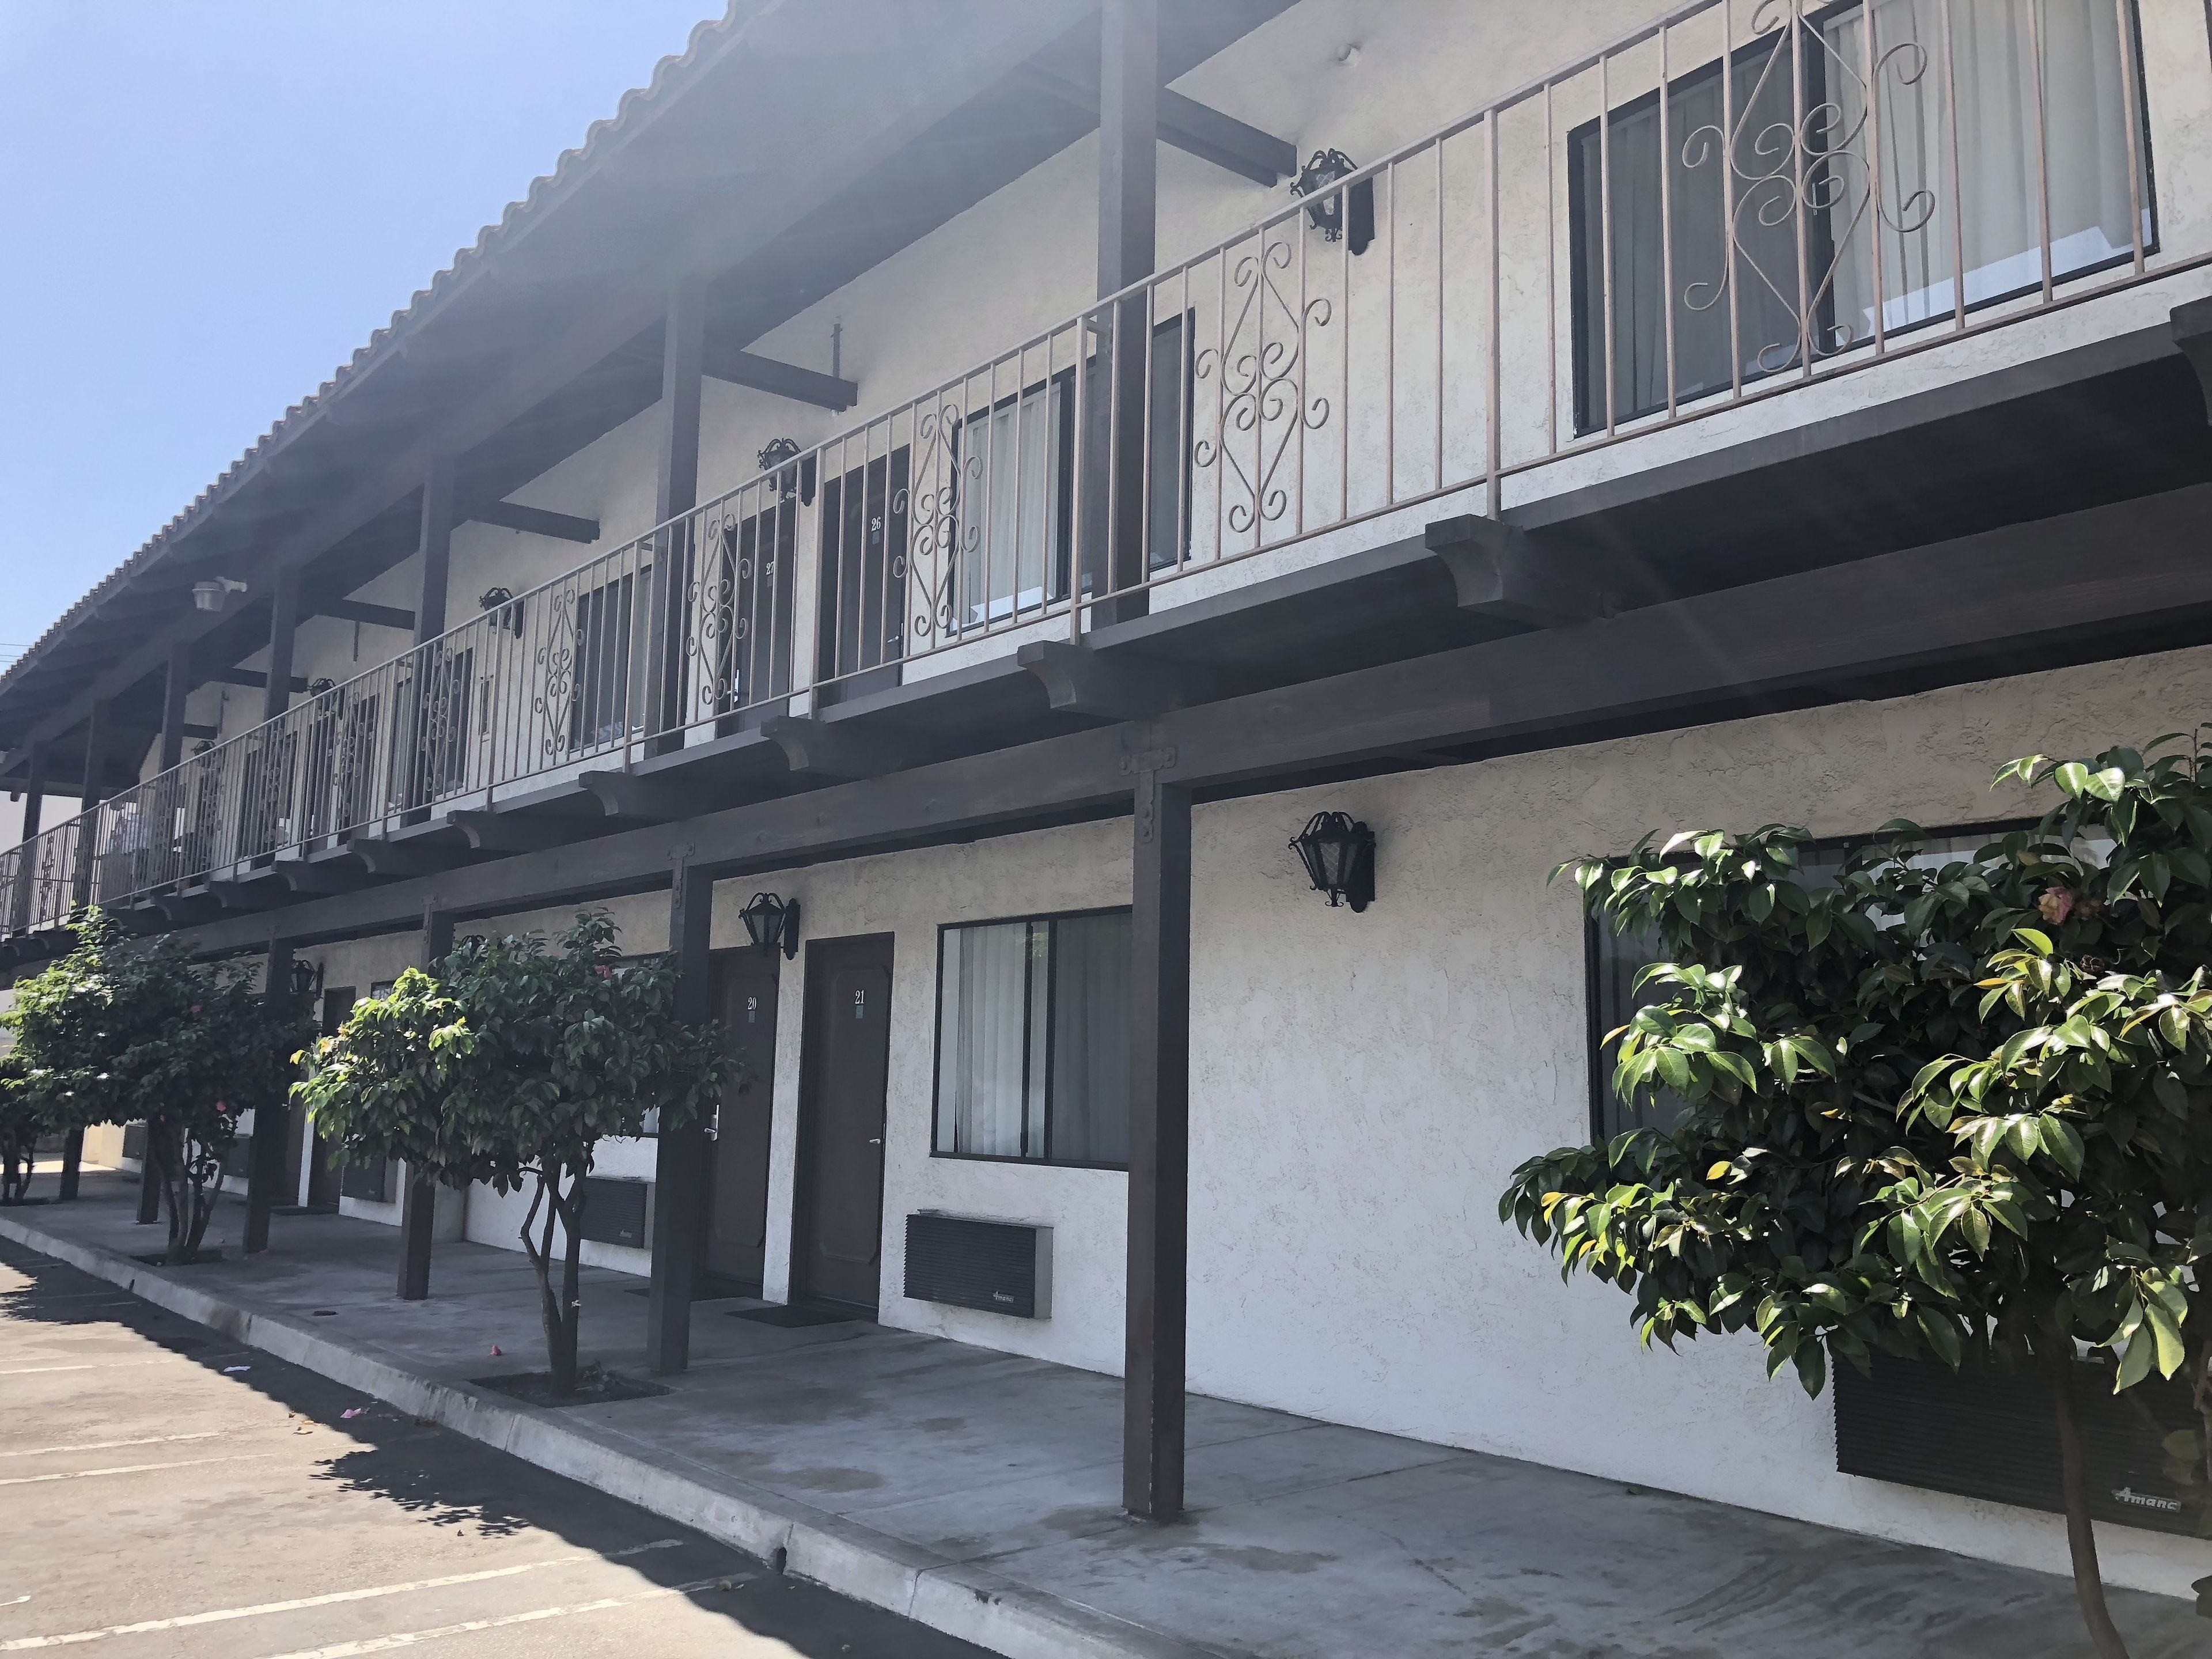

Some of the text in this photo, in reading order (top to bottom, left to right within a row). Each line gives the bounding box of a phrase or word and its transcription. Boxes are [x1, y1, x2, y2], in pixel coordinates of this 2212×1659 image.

[871, 516, 881, 532] 26
[748, 997, 757, 1010] 20
[855, 989, 865, 1004] 21
